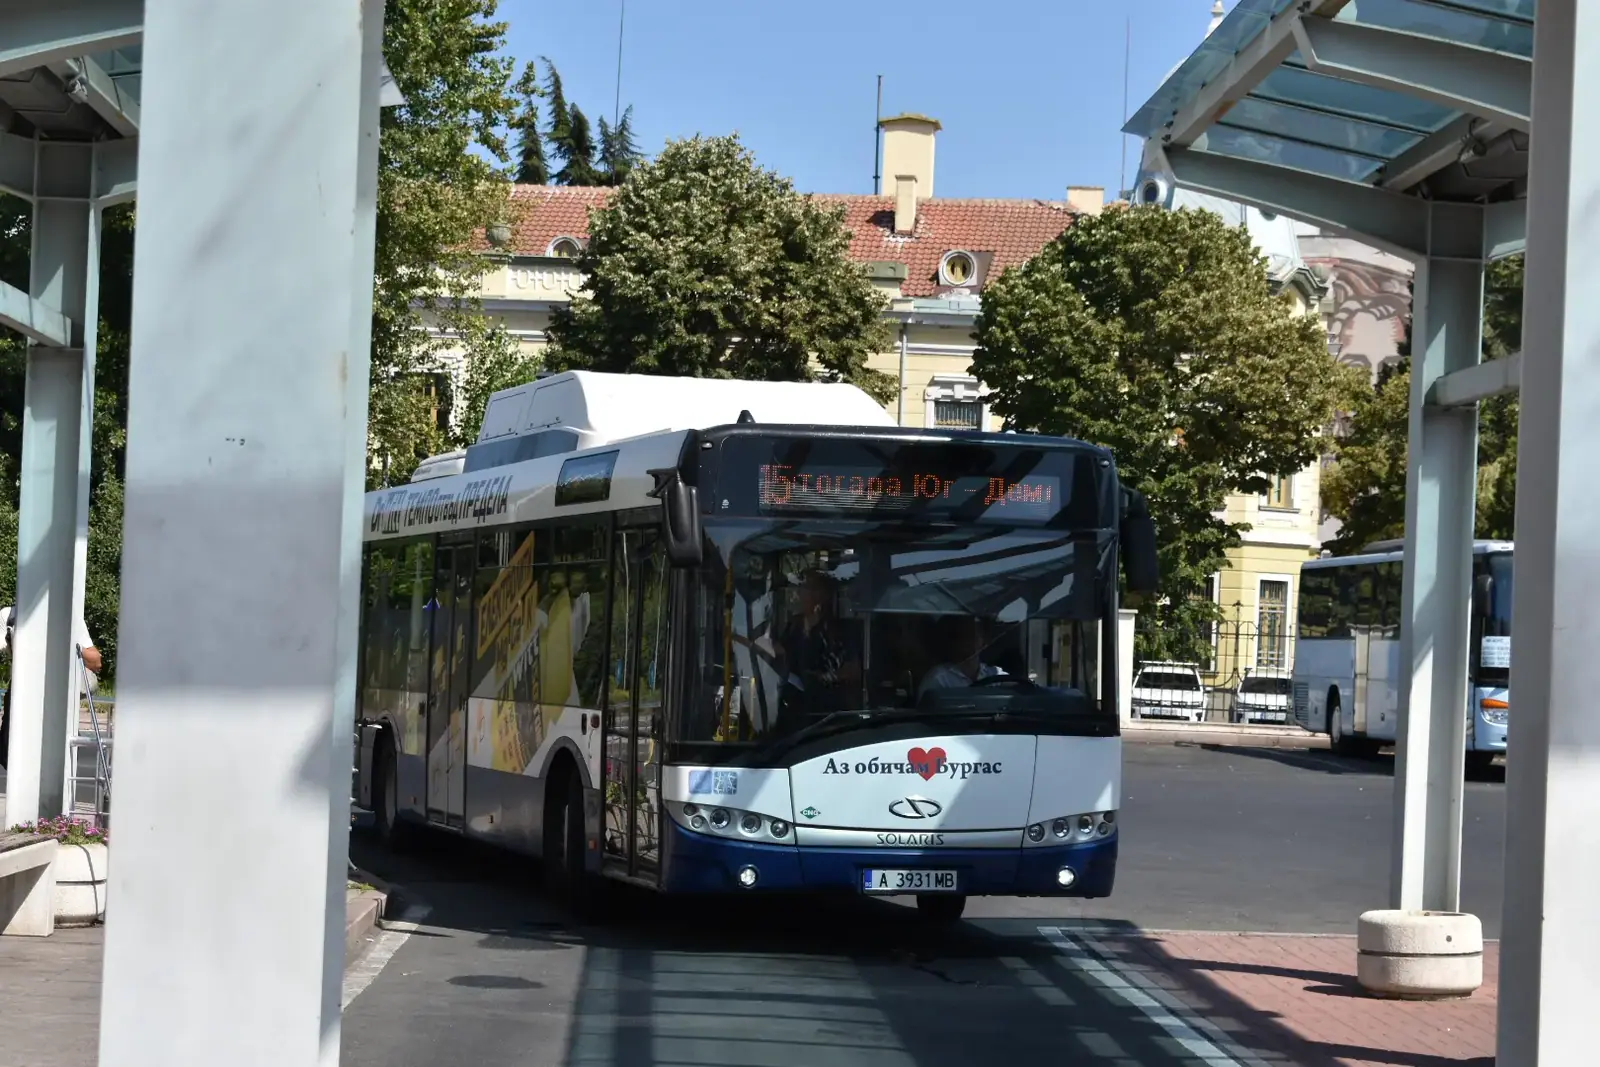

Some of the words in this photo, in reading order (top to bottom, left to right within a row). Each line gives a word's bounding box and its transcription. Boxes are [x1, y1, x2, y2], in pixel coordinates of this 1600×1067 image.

[760, 464, 792, 505] 15
[913, 473, 956, 499] Юг
[458, 474, 514, 524] ПРЕДЕЛА
[823, 758, 850, 775] Аз
[855, 756, 930, 775] обичам
[935, 757, 1002, 780] Бургас
[802, 808, 820, 817] CNG
[876, 833, 944, 846] SOLARIS
[879, 872, 888, 888] A
